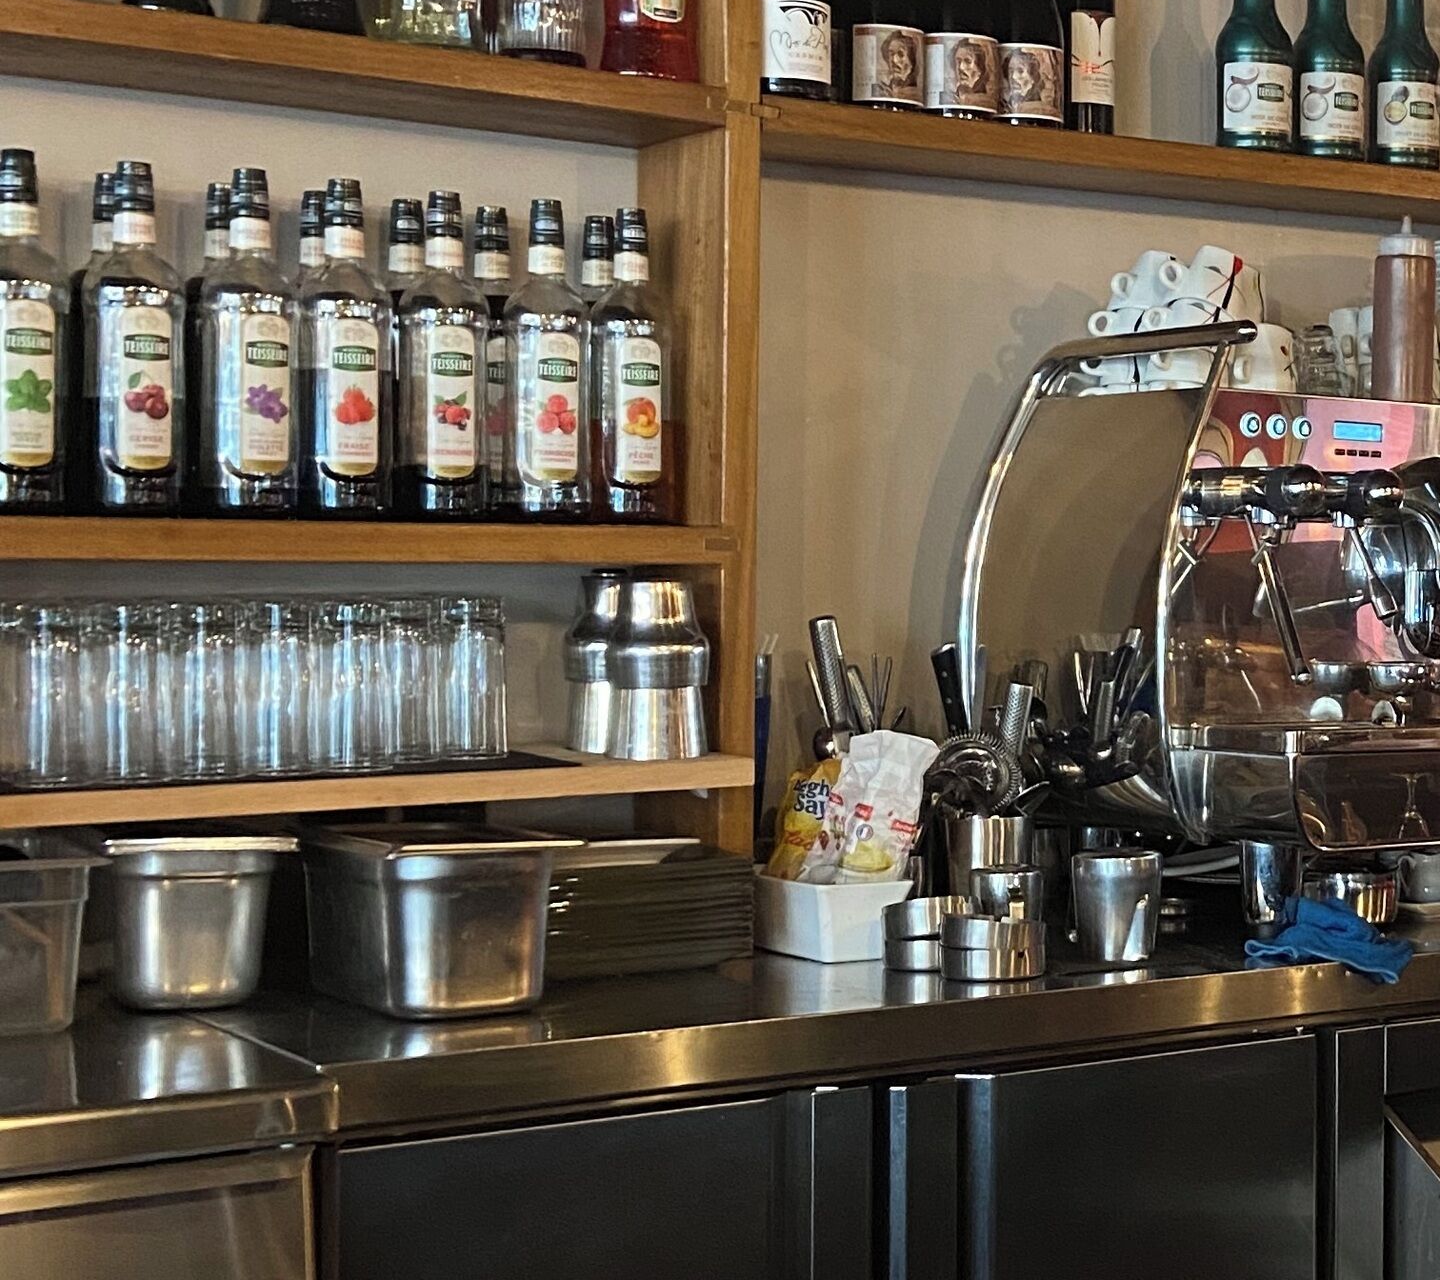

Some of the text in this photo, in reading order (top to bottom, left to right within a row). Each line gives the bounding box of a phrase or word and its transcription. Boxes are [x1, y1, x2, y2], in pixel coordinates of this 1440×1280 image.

[334, 352, 375, 366] TEISSEIRE
[432, 358, 472, 371] TEISSEIRE
[539, 363, 576, 377] TEISSEIRE
[622, 369, 659, 381] TEISSEIRE
